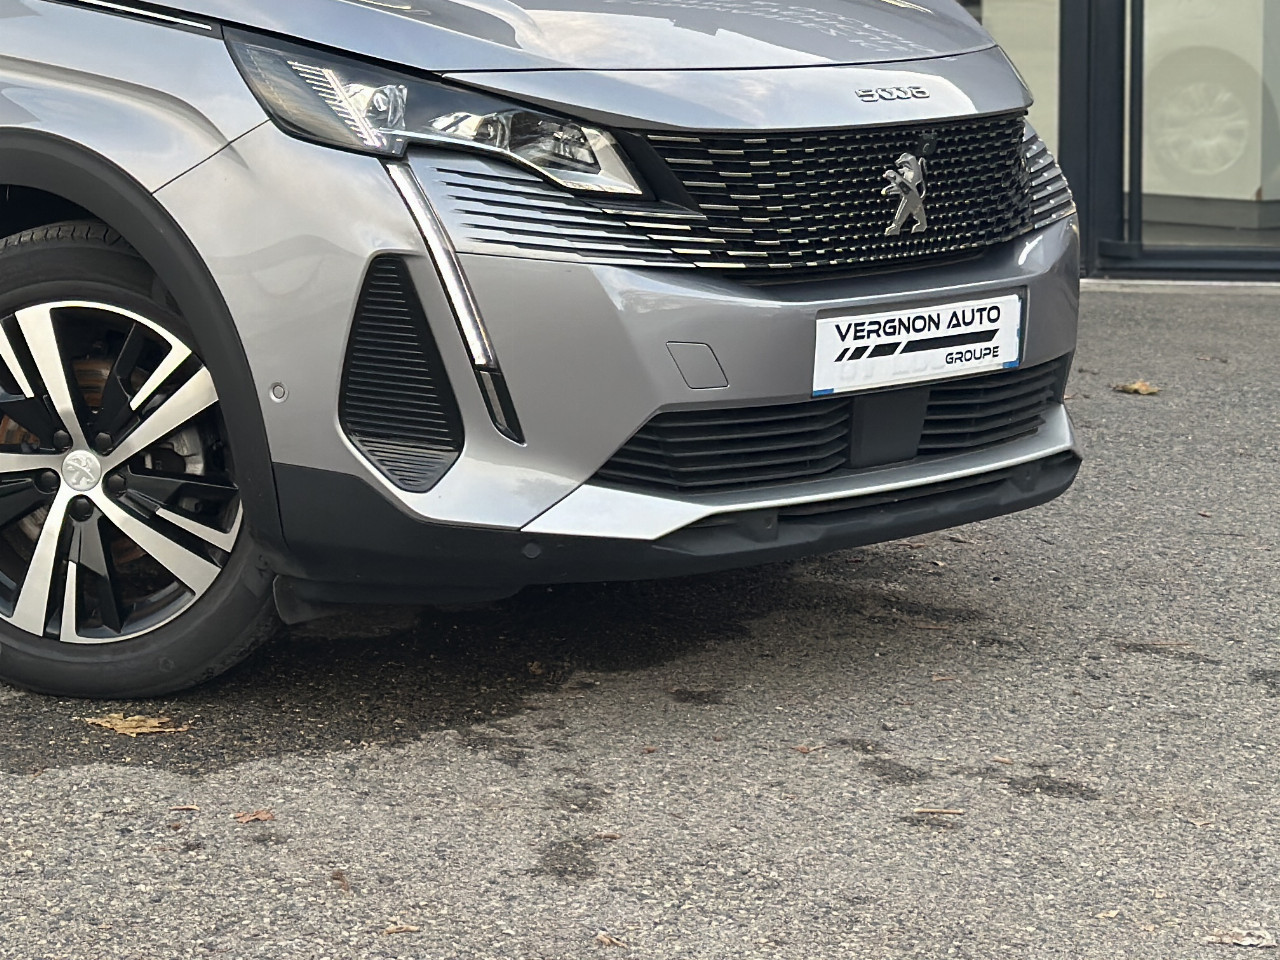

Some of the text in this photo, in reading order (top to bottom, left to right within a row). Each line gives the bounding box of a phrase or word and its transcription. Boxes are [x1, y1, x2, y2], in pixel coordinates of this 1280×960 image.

[835, 305, 1001, 342] VERGNON AUTO
[945, 346, 1000, 364] GROUPE
